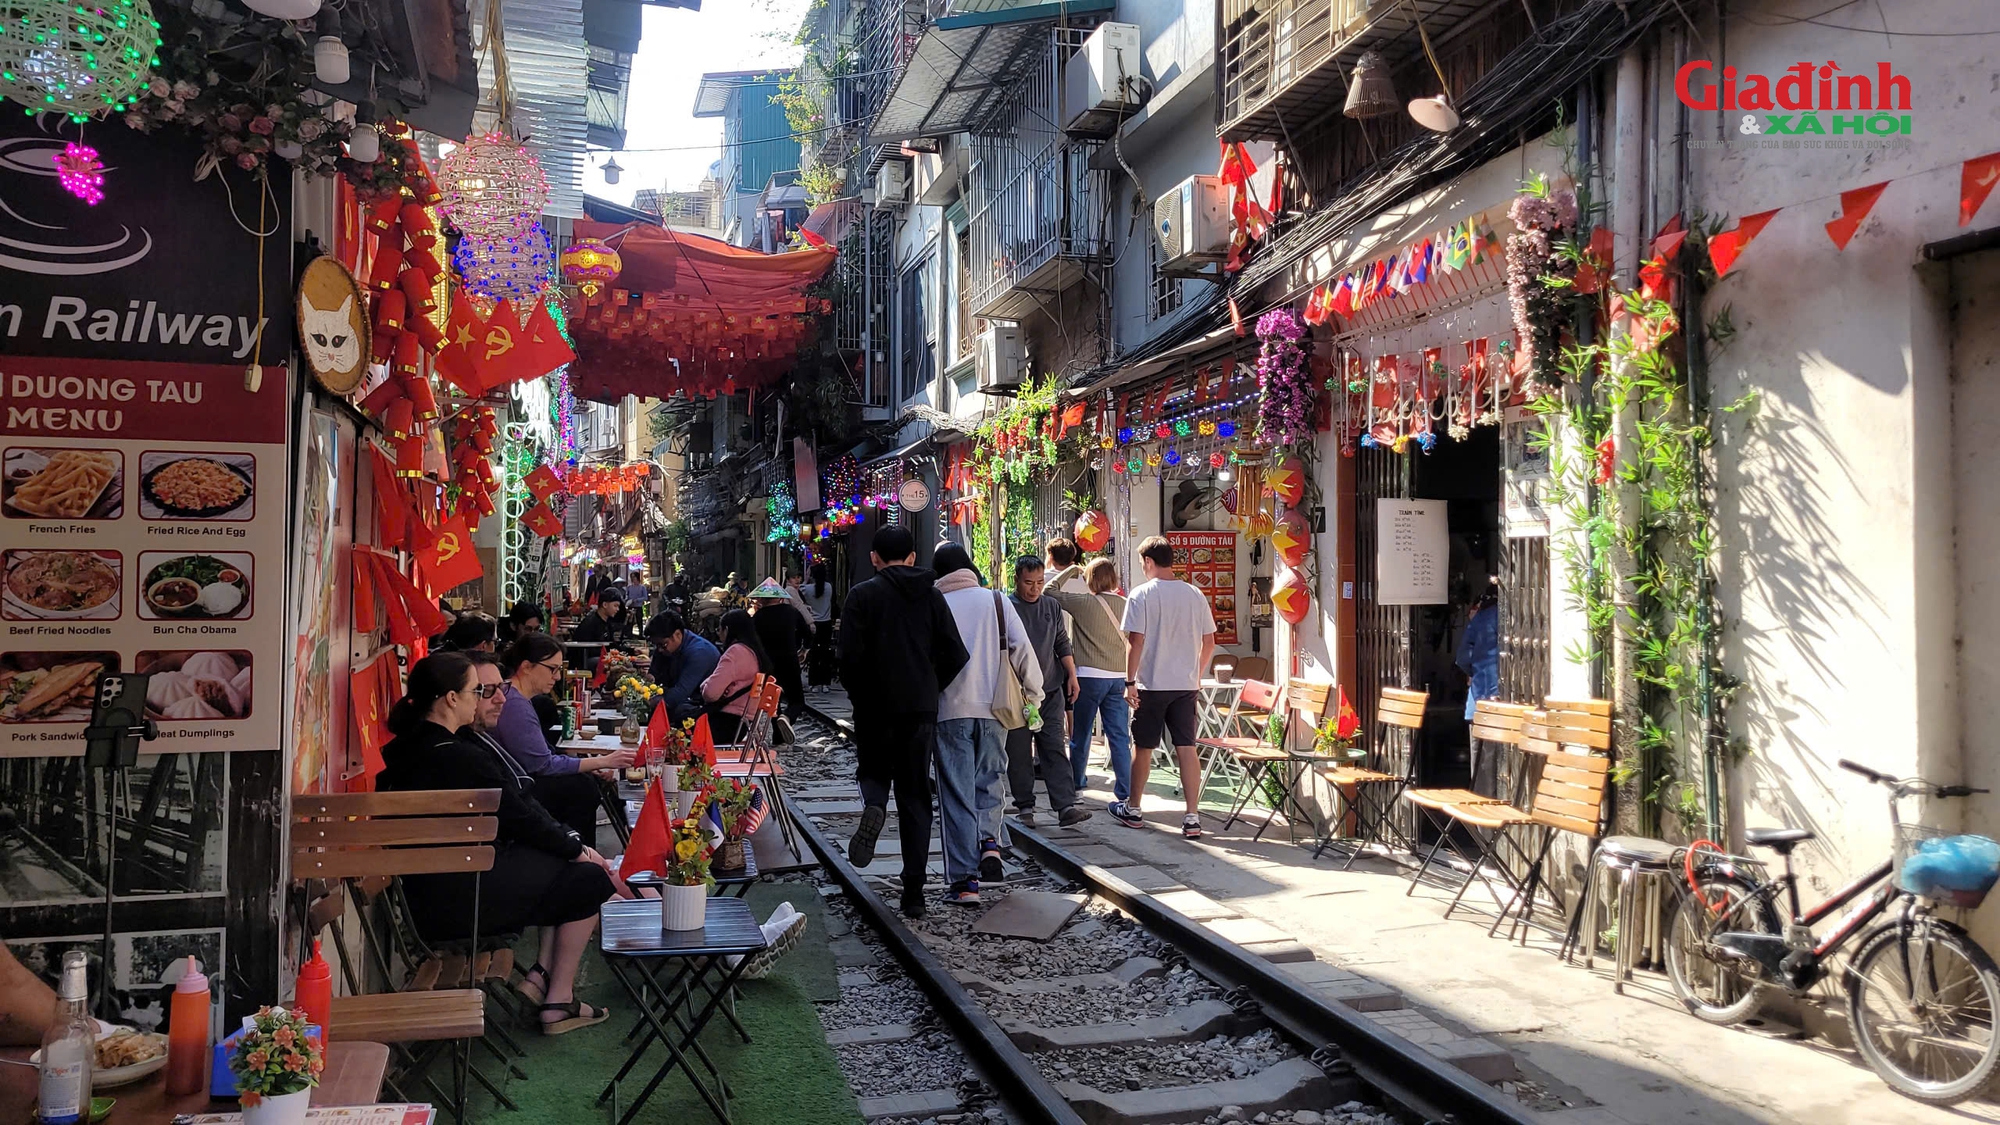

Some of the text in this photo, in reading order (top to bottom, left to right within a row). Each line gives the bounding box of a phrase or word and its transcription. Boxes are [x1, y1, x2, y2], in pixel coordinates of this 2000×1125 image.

[42, 295, 270, 359] Railway
[11, 375, 136, 401] DUONG
[146, 380, 203, 404] TAU
[6, 406, 123, 432] MENU
[914, 490, 925, 499] 15
[29, 524, 96, 534] French Fries
[147, 526, 246, 538] Fried Rice And Egg
[1170, 534, 1233, 546] SỐ 9 ĐƯỜNG TÀU
[9, 626, 112, 635] Beef Fried Noodles
[153, 625, 237, 635] Bun Cha Obama
[11, 731, 86, 742] Pork Sandwic
[179, 728, 235, 739] Dumplings
